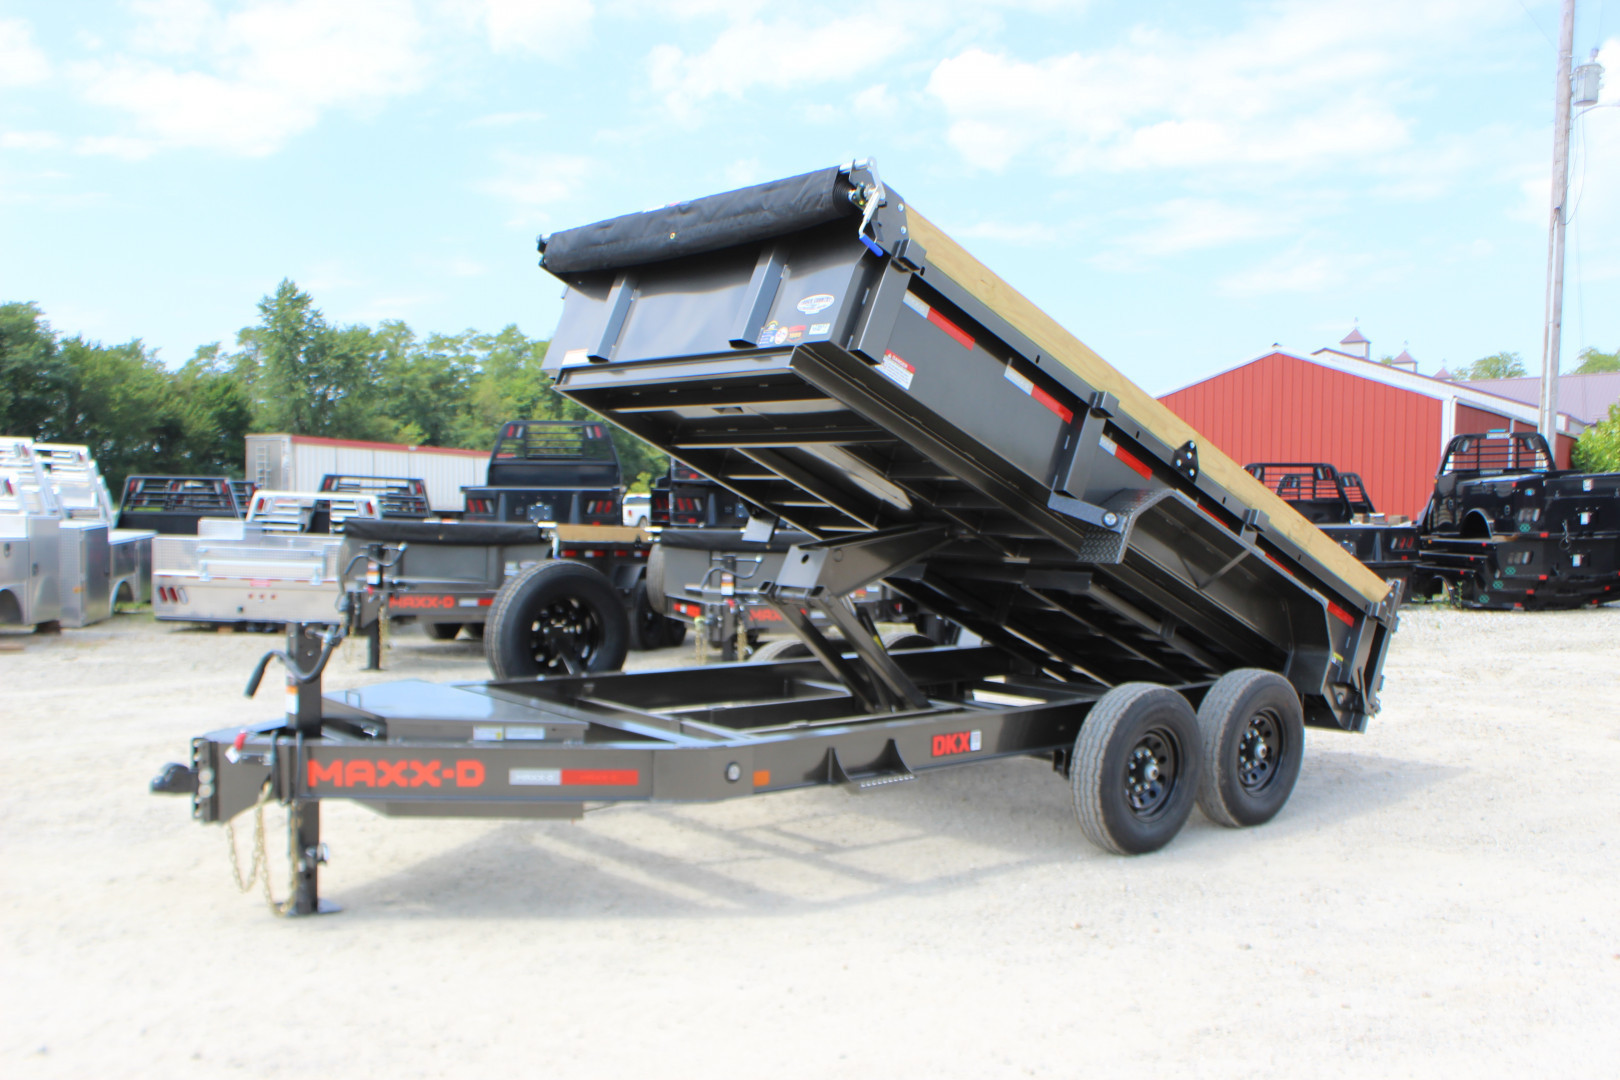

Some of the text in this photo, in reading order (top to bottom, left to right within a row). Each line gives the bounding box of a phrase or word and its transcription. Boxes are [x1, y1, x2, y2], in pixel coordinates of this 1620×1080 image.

[389, 595, 455, 608] MAXX-D
[932, 731, 971, 757] DKX
[307, 759, 485, 788] MAXX-D
